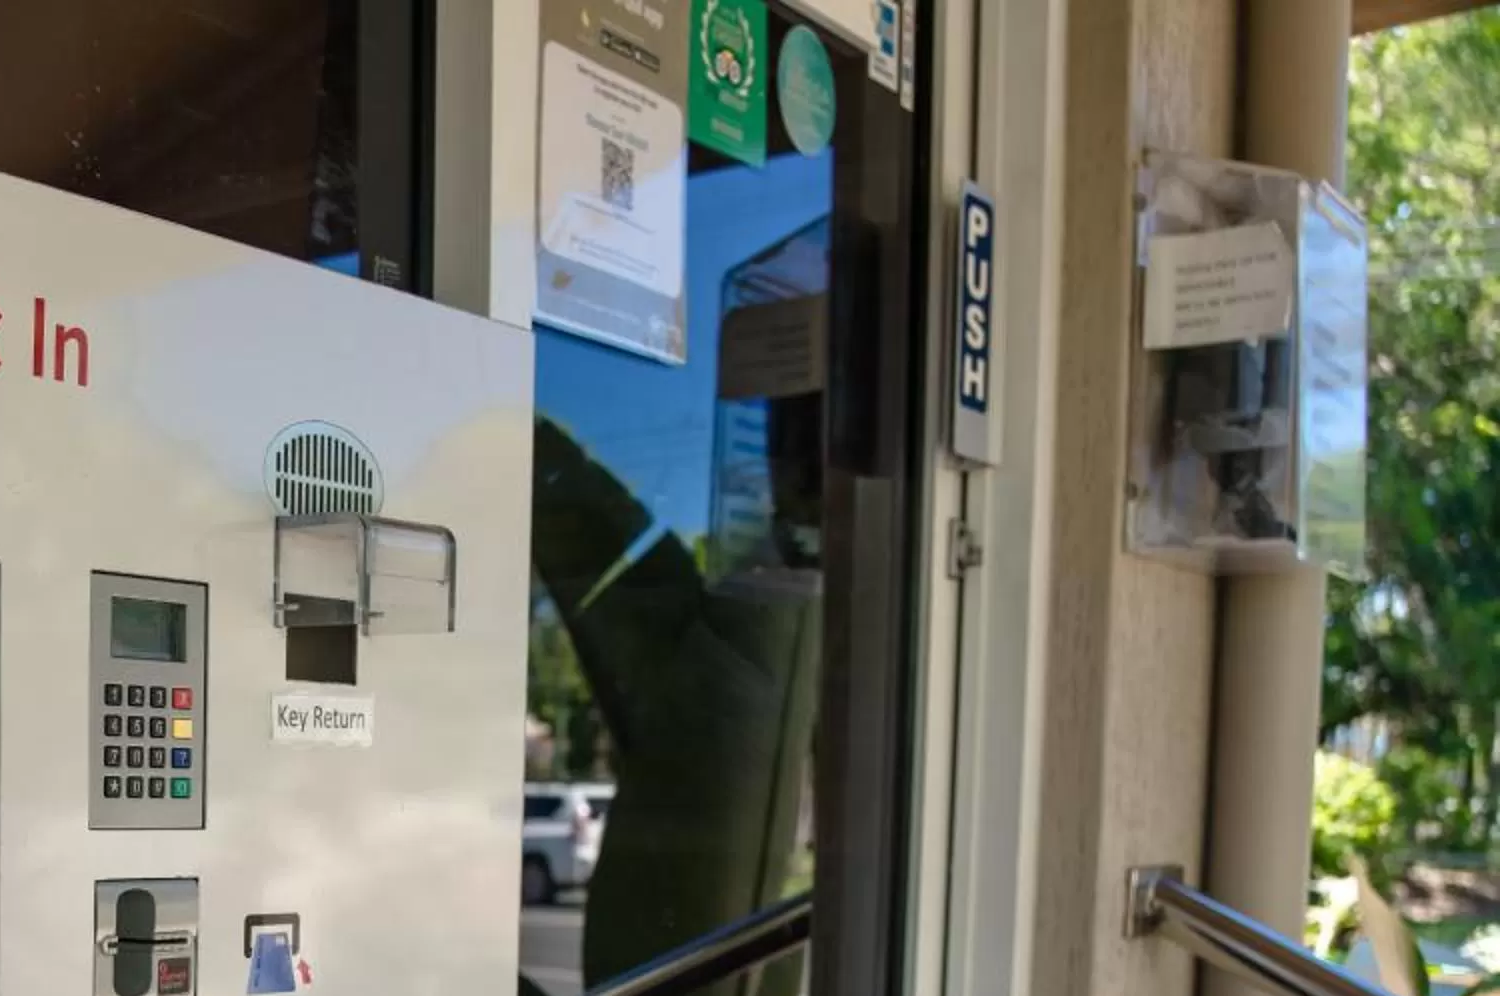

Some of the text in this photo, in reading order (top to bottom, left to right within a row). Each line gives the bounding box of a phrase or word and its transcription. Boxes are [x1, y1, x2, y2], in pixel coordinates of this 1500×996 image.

[33, 297, 89, 386] In
[963, 204, 989, 401] PUSH
[277, 703, 366, 733] Key Return
